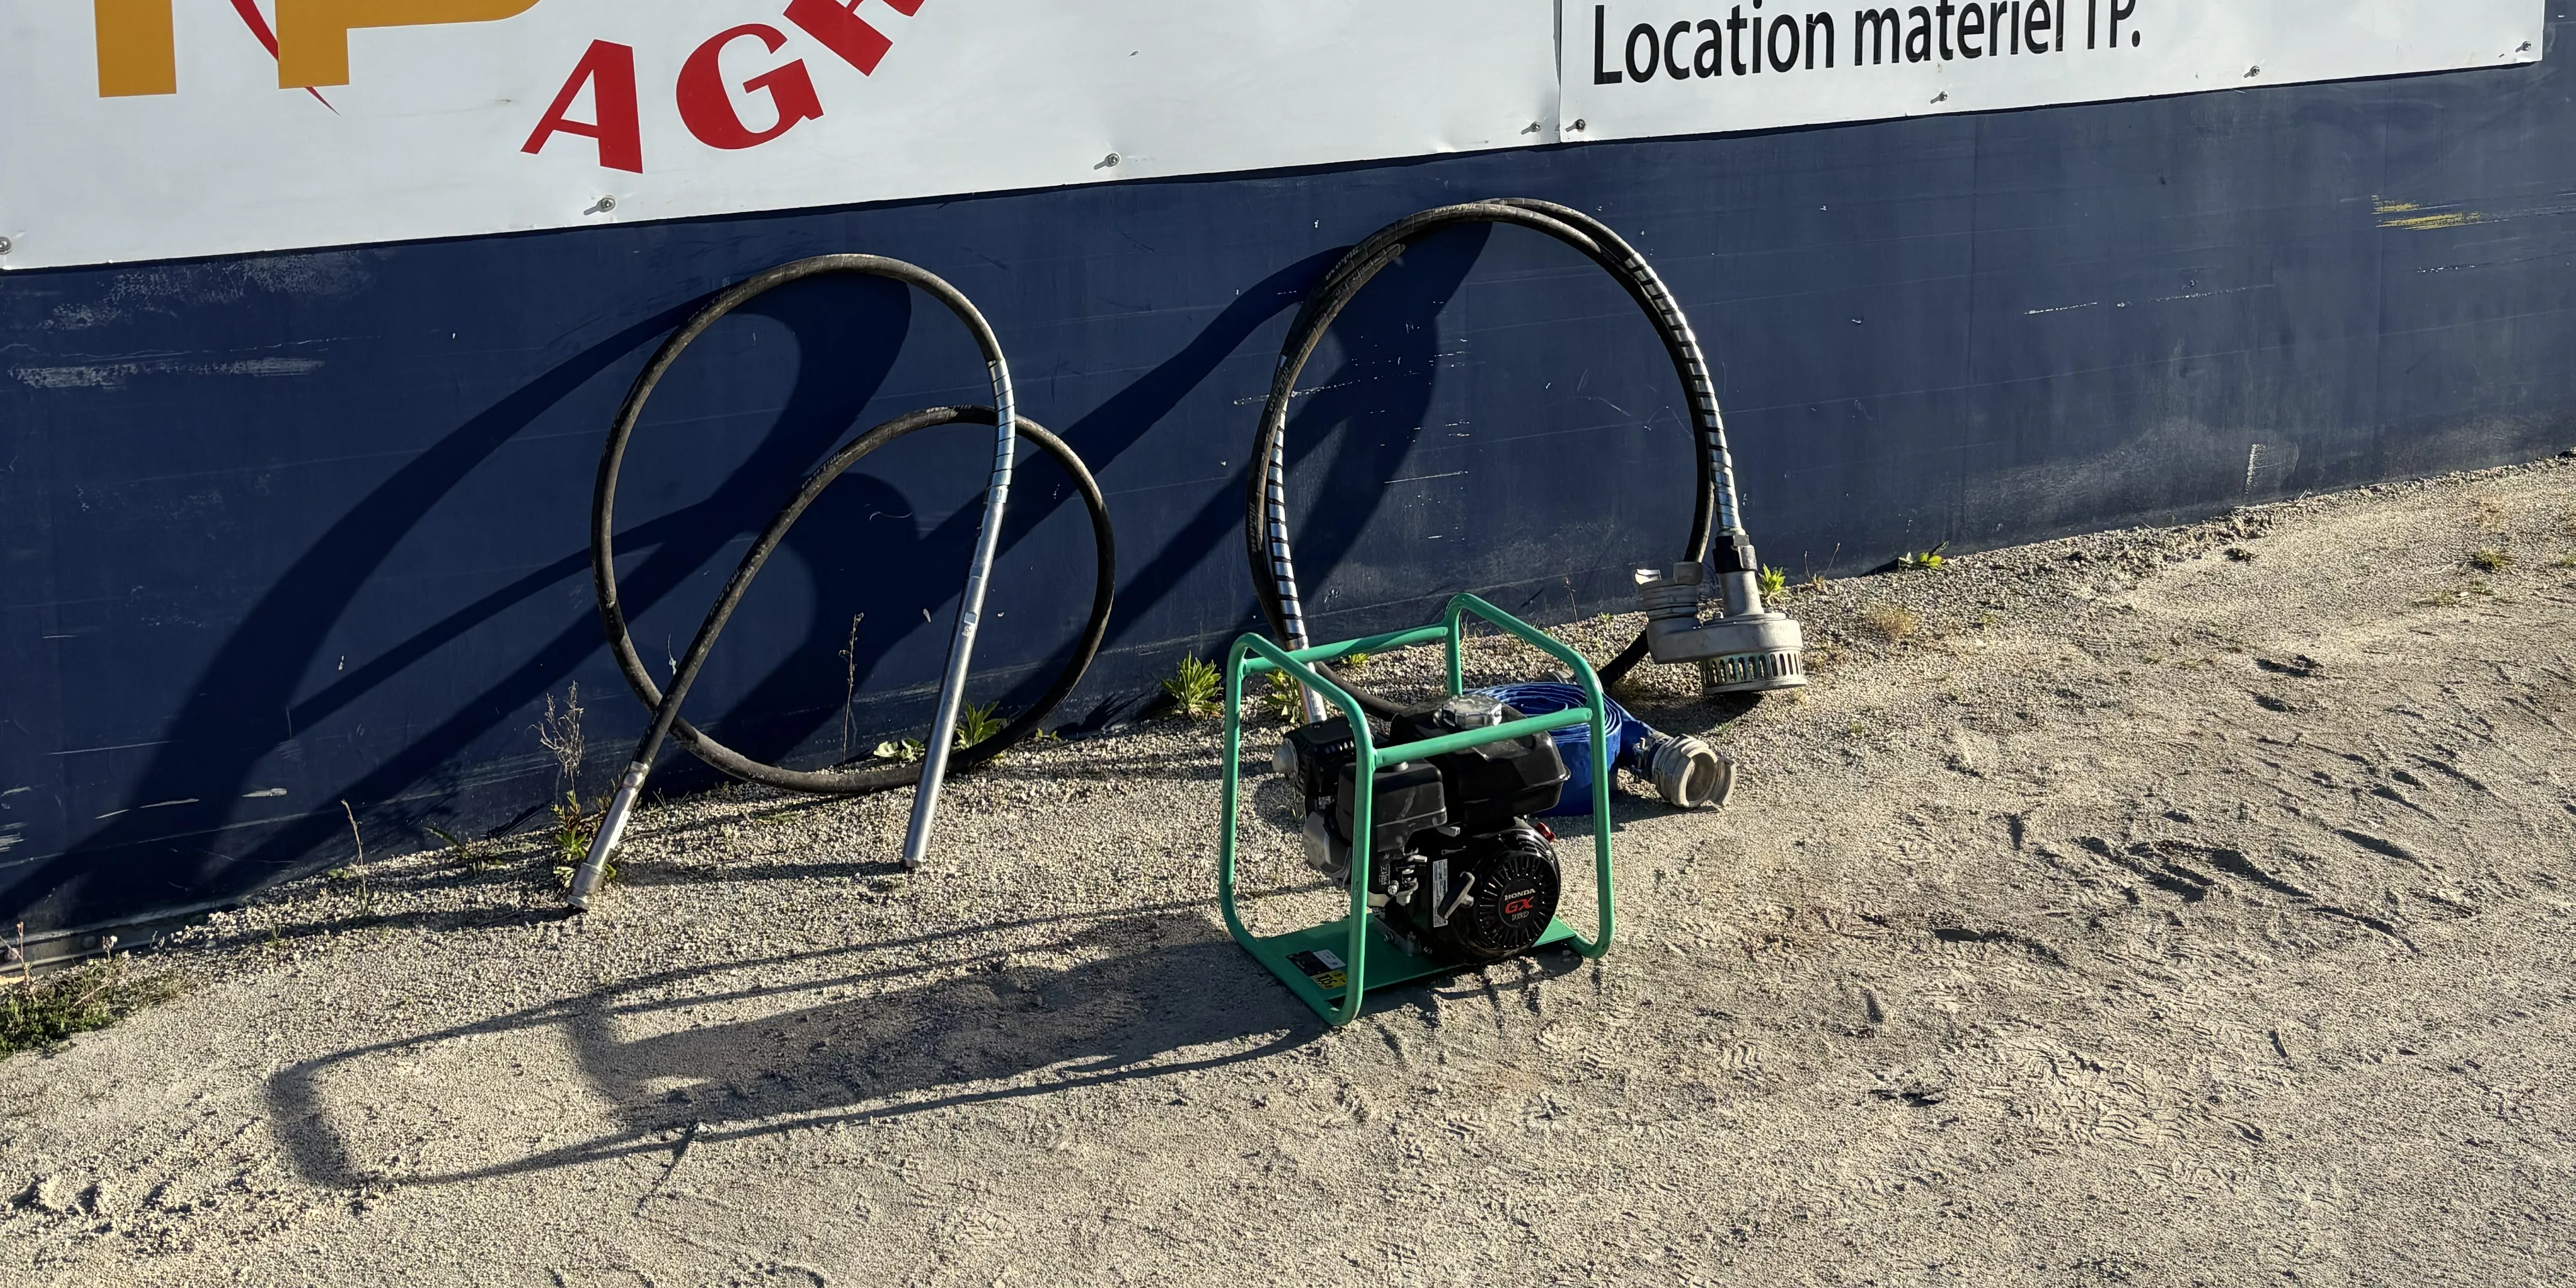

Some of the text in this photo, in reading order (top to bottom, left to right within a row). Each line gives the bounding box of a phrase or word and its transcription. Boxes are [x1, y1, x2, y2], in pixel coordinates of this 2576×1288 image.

[1594, 0, 1834, 85] Location
[1504, 888, 1536, 901] HONDA
[1505, 896, 1534, 914] GX
